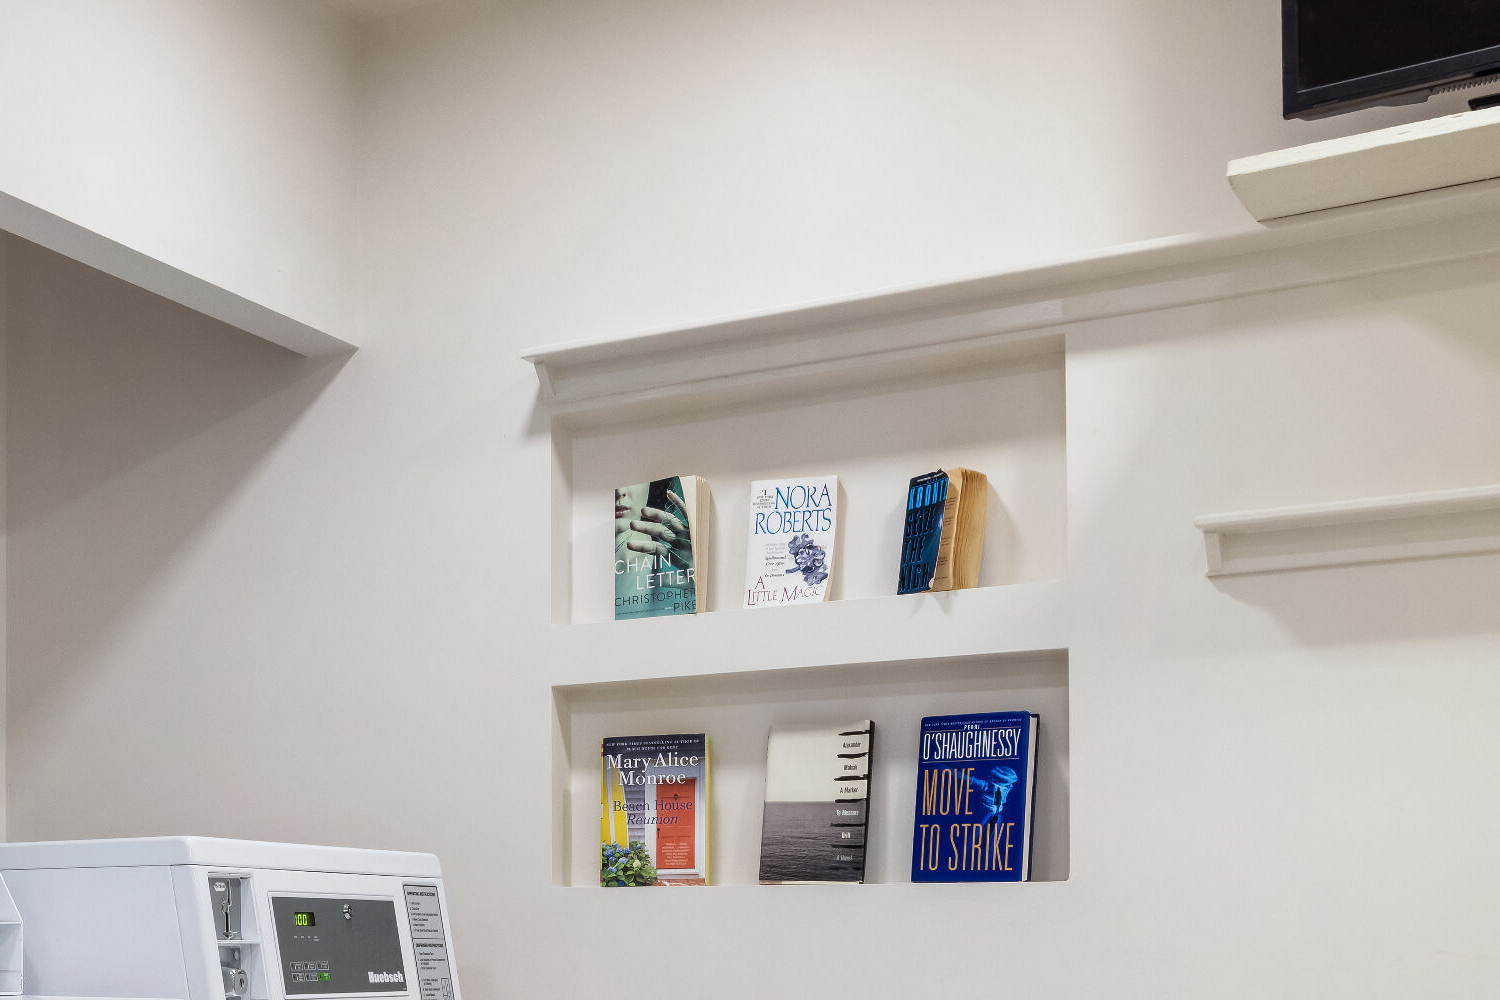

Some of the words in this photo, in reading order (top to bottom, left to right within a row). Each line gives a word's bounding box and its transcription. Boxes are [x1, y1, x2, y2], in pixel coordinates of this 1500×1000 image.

[775, 483, 832, 510] NORA
[754, 507, 832, 535] ROBERTS
[614, 552, 672, 575] CHAIN
[636, 567, 695, 590] LETTER
[754, 575, 766, 590] A
[615, 587, 696, 607] CHRISTOPHER
[673, 599, 696, 613] PIKE
[747, 589, 778, 606] LITTLE
[781, 585, 821, 602] MAGIC
[923, 729, 1022, 760] O'SHAUGHNESSY
[606, 753, 651, 773] Mary
[655, 752, 699, 769] Alice
[618, 770, 686, 786] Monroe
[922, 767, 975, 816] MOVE
[613, 799, 651, 812] Beach
[654, 799, 693, 811] House
[626, 814, 679, 825] Reunion
[920, 823, 940, 871] TO
[948, 823, 1016, 871] STRIKE
[295, 913, 308, 926] 100
[367, 971, 404, 984] Huebsch
